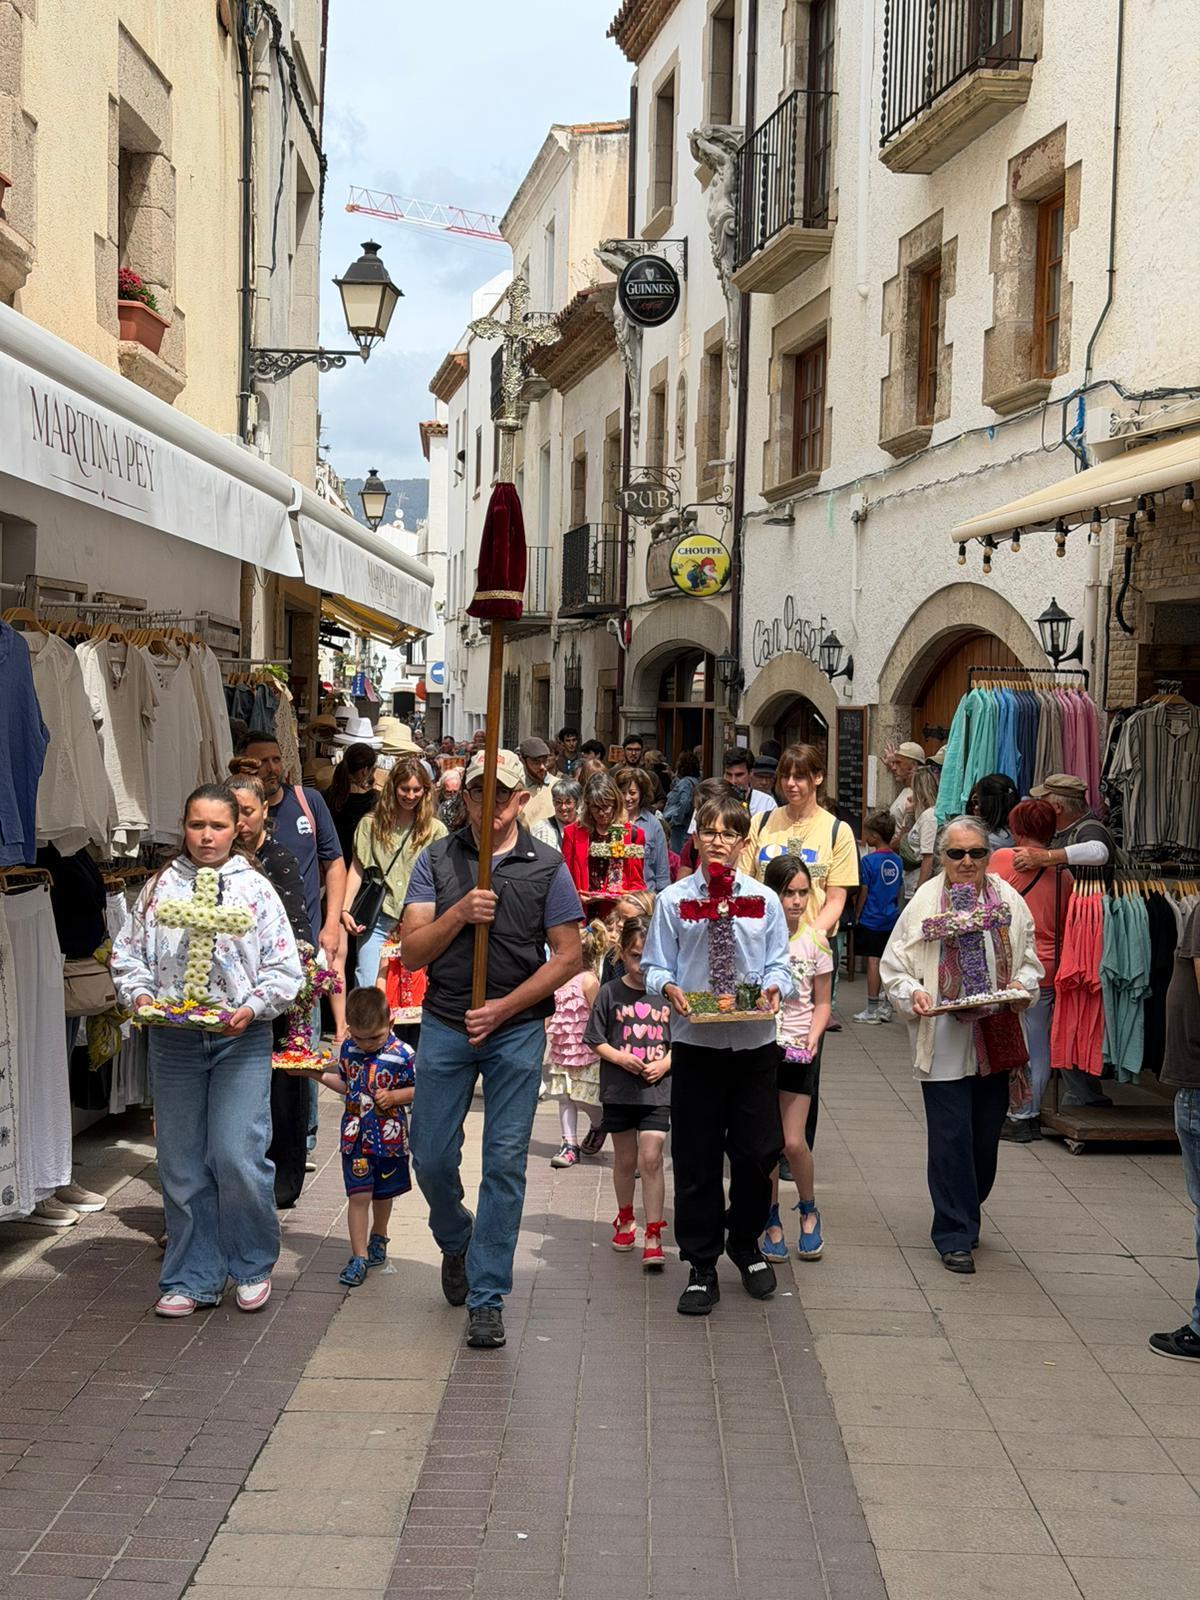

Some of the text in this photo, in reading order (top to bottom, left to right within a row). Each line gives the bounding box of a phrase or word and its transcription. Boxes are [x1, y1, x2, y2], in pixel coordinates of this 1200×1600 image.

[626, 282, 675, 295] GUINNESS
[30, 385, 154, 492] MARTINA PEY
[622, 489, 671, 509] PUB
[678, 546, 723, 555] CHOUFFE
[753, 618, 782, 668] Can
